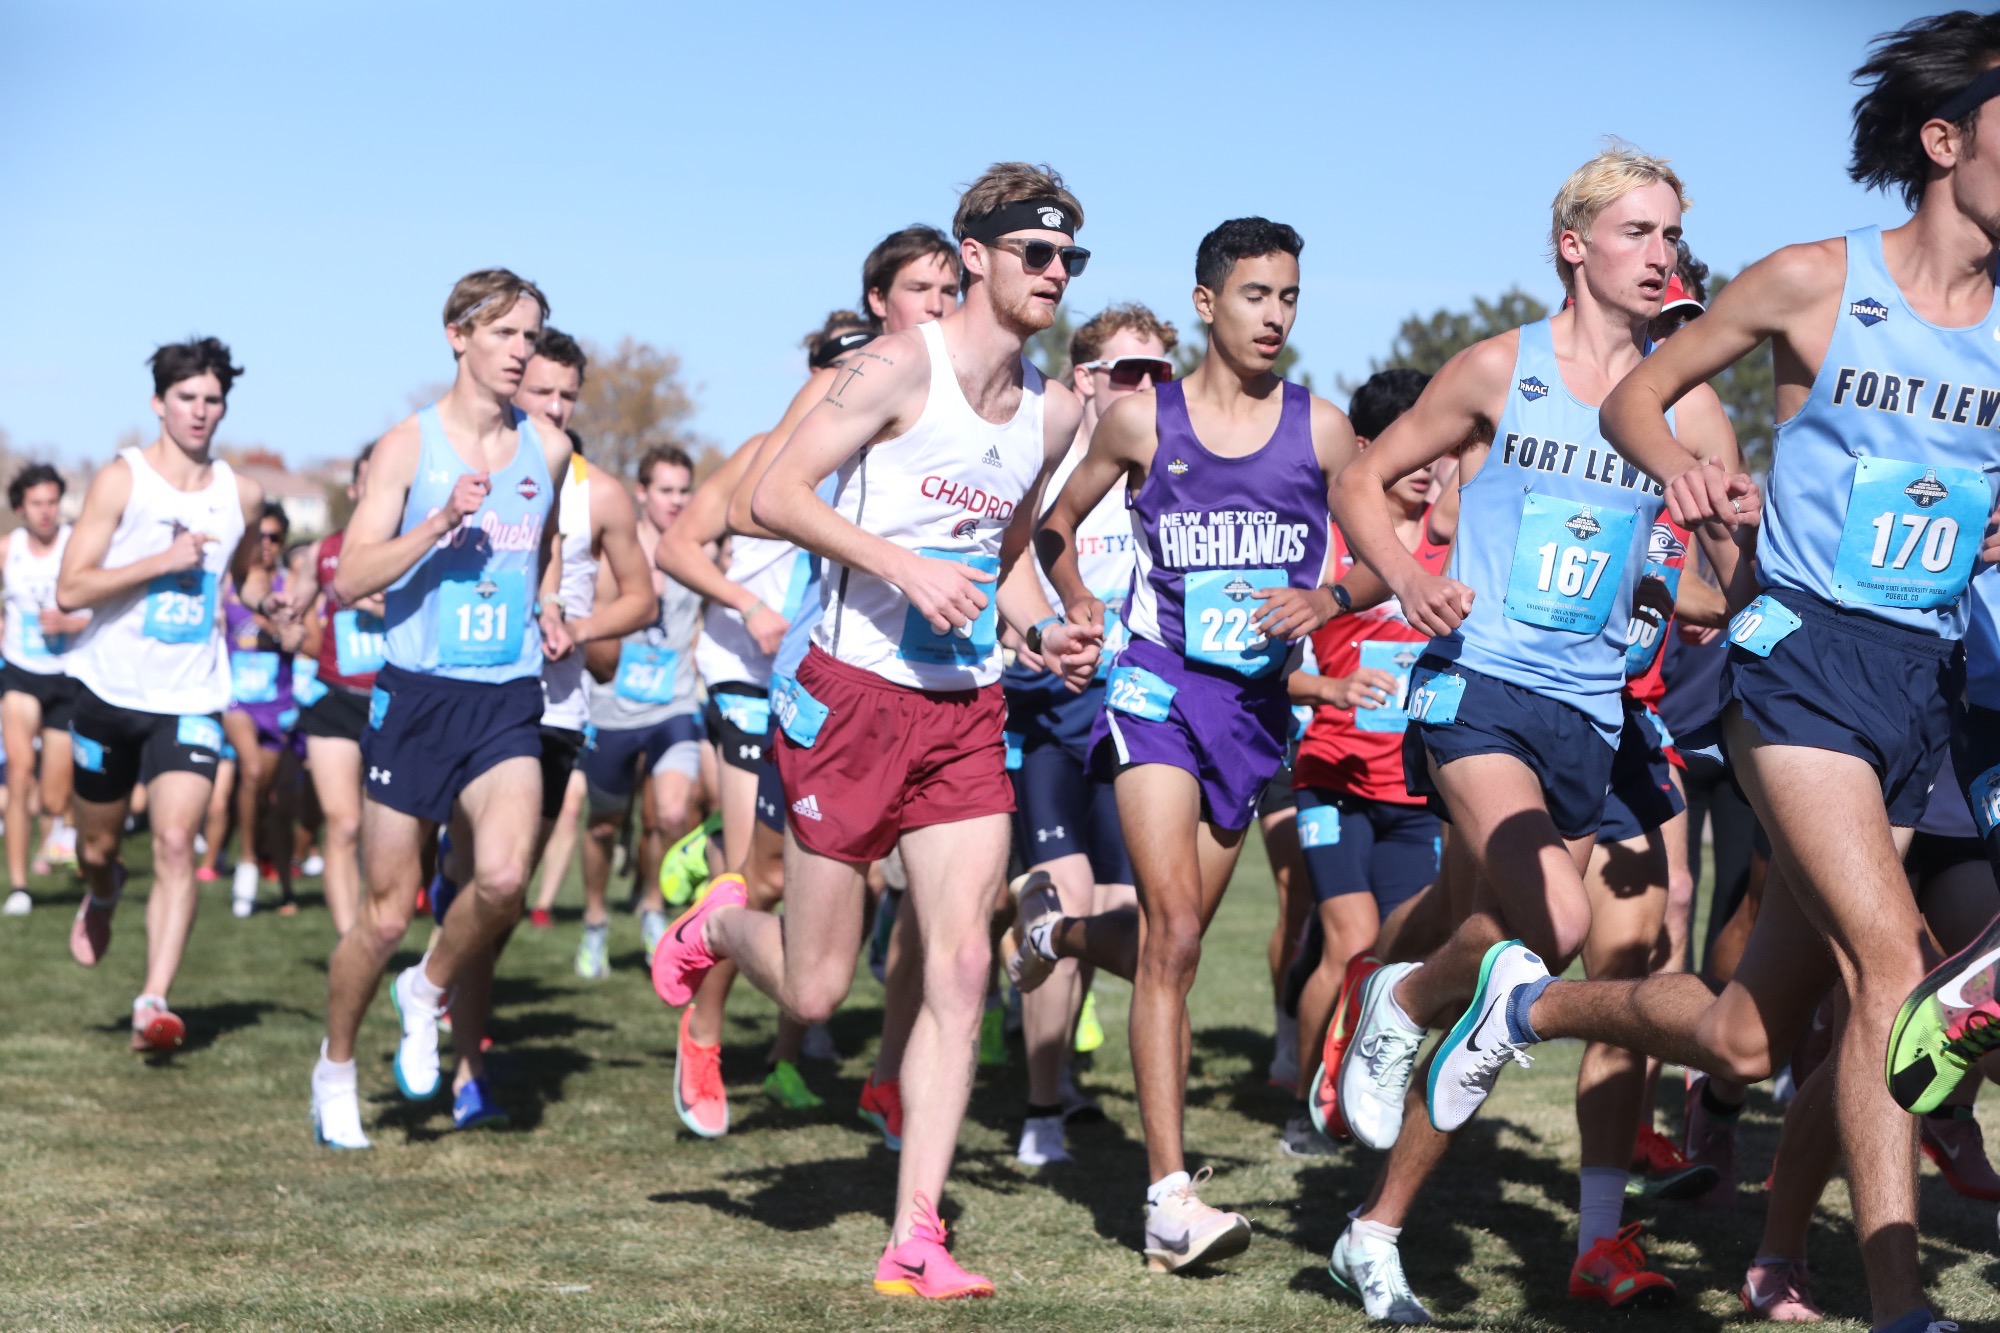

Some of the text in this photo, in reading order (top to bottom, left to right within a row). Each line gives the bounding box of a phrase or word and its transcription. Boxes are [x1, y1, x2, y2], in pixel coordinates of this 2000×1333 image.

[1851, 303, 1887, 320] RMAC
[1520, 379, 1548, 395] RMAC
[1831, 367, 2000, 431] FORT LEW
[982, 456, 1002, 469] adidas
[1167, 463, 1189, 473] RMAC
[1502, 432, 1579, 476] FORT
[920, 475, 1014, 522] CHADRO
[475, 509, 543, 554] Puebl
[1160, 510, 1277, 528] NEW MEXICO
[1159, 523, 1309, 568] HIGHLANDS
[1871, 511, 1960, 573] 170
[1538, 542, 1611, 600] 167
[155, 591, 206, 626] 235
[456, 602, 508, 642] 131
[1109, 678, 1150, 713] 225
[793, 803, 822, 821] adidas
